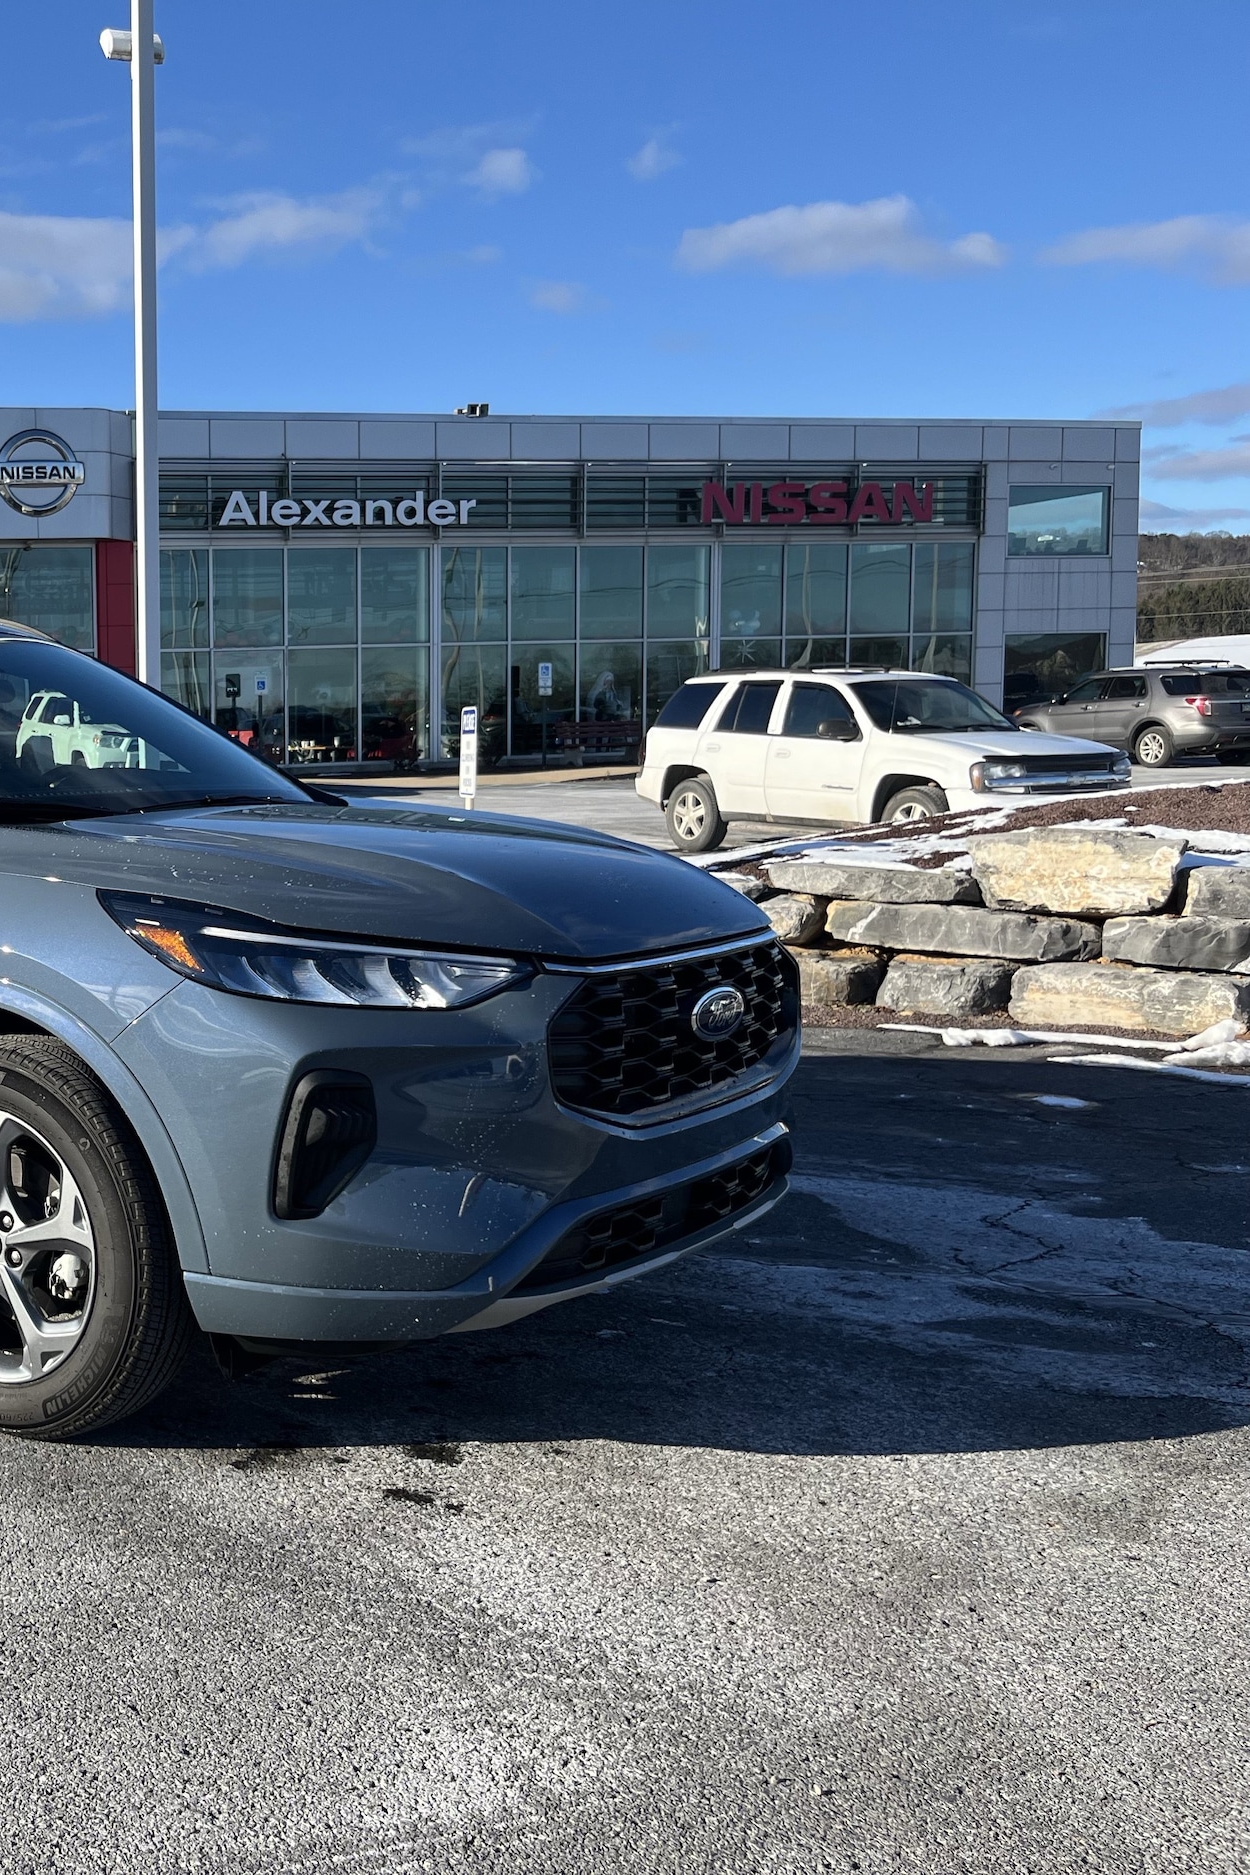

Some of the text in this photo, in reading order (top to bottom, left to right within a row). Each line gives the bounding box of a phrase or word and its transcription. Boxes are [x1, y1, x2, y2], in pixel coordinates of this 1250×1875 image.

[0, 465, 76, 480] NISSAN
[218, 490, 477, 526] Alexander
[702, 482, 934, 523] NISSAN
[44, 1349, 108, 1416] MICHELIN
[0, 1411, 34, 1421] 225/60
